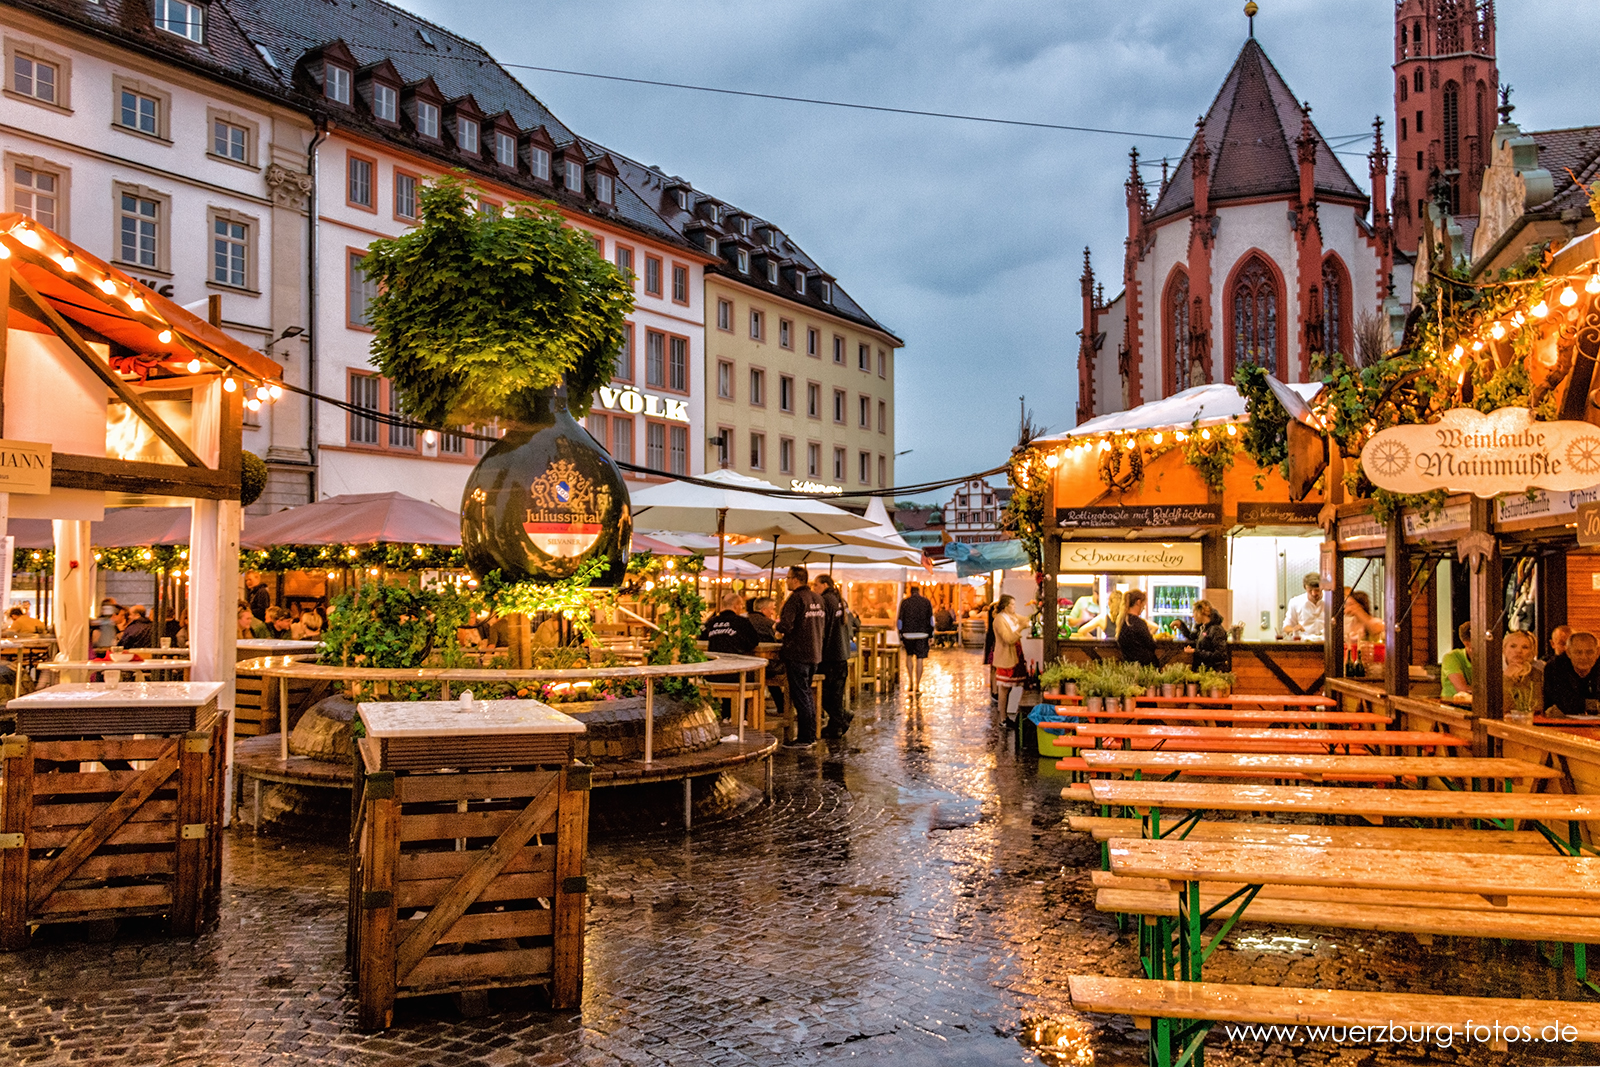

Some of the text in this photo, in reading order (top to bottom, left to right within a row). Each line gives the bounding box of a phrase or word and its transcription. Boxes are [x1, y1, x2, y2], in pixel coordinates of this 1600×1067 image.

[600, 385, 690, 422] VÖLK
[1435, 428, 1546, 449] Weinlaube
[1415, 450, 1562, 479] Mainmühle
[526, 509, 600, 524] Juliusspital
[1132, 508, 1149, 519] mit
[1070, 547, 1184, 568] Schwarzriesling
[708, 627, 737, 637] security
